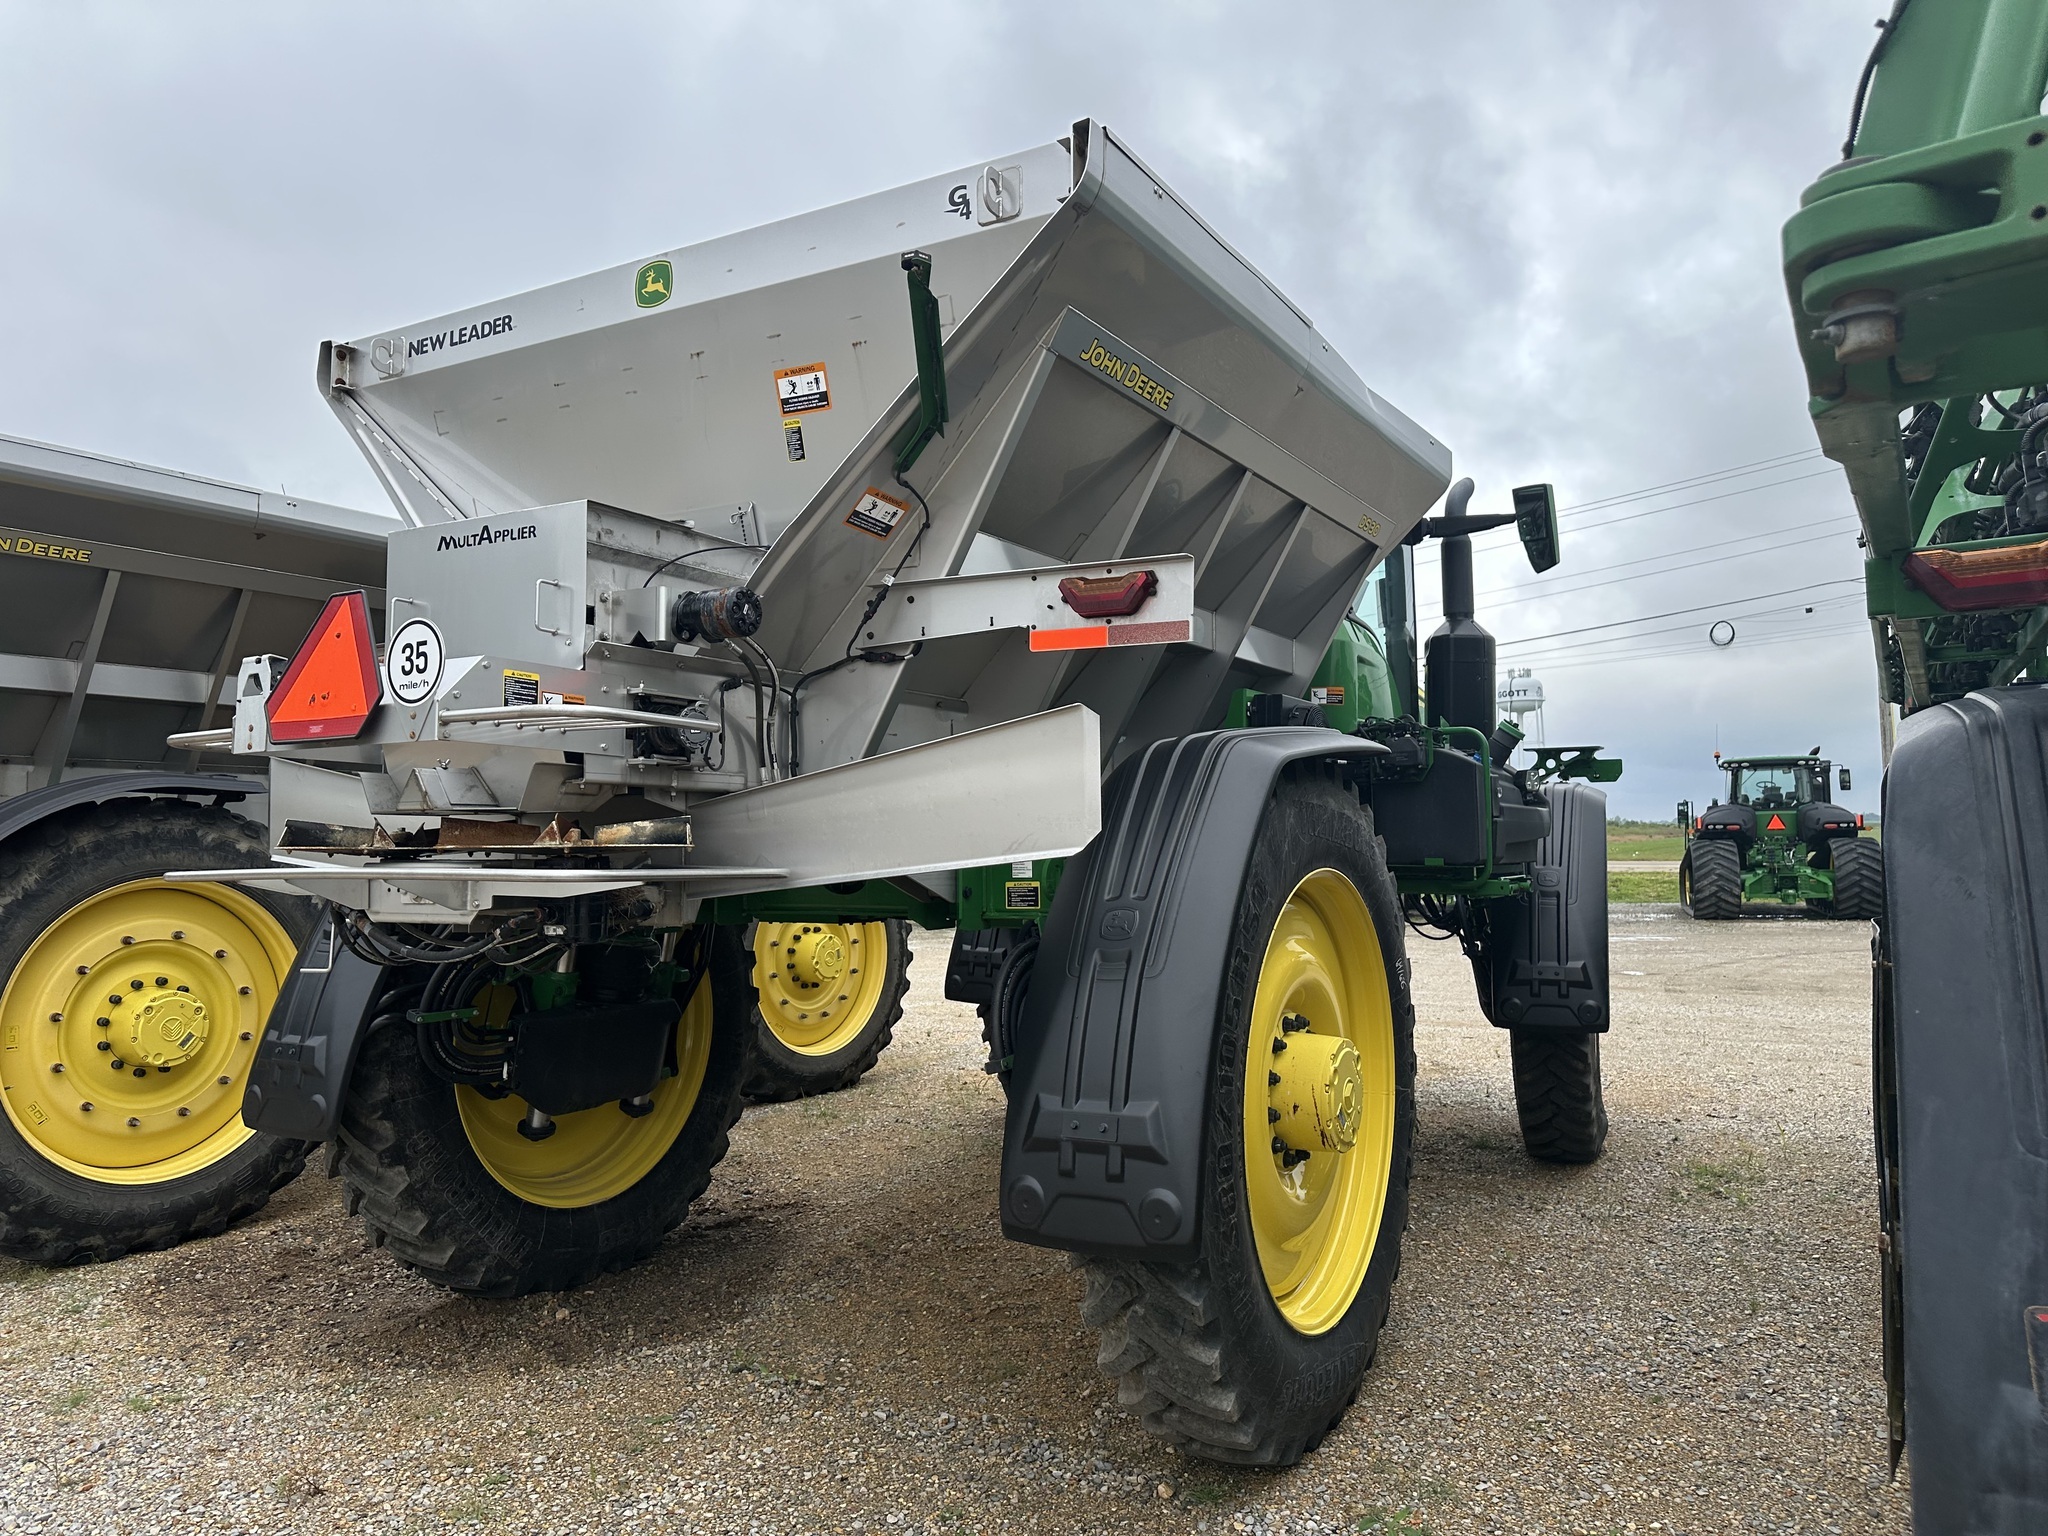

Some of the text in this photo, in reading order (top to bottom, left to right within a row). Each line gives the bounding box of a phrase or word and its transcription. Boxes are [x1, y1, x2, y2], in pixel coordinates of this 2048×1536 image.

[408, 314, 513, 358] NEW LEADER
[789, 365, 815, 375] WARNING
[1079, 337, 1175, 411] JOHN DEERE
[880, 493, 902, 507] WARNING
[15, 537, 93, 563] DEERE
[401, 640, 428, 677] 35
[399, 680, 430, 691] mile/h
